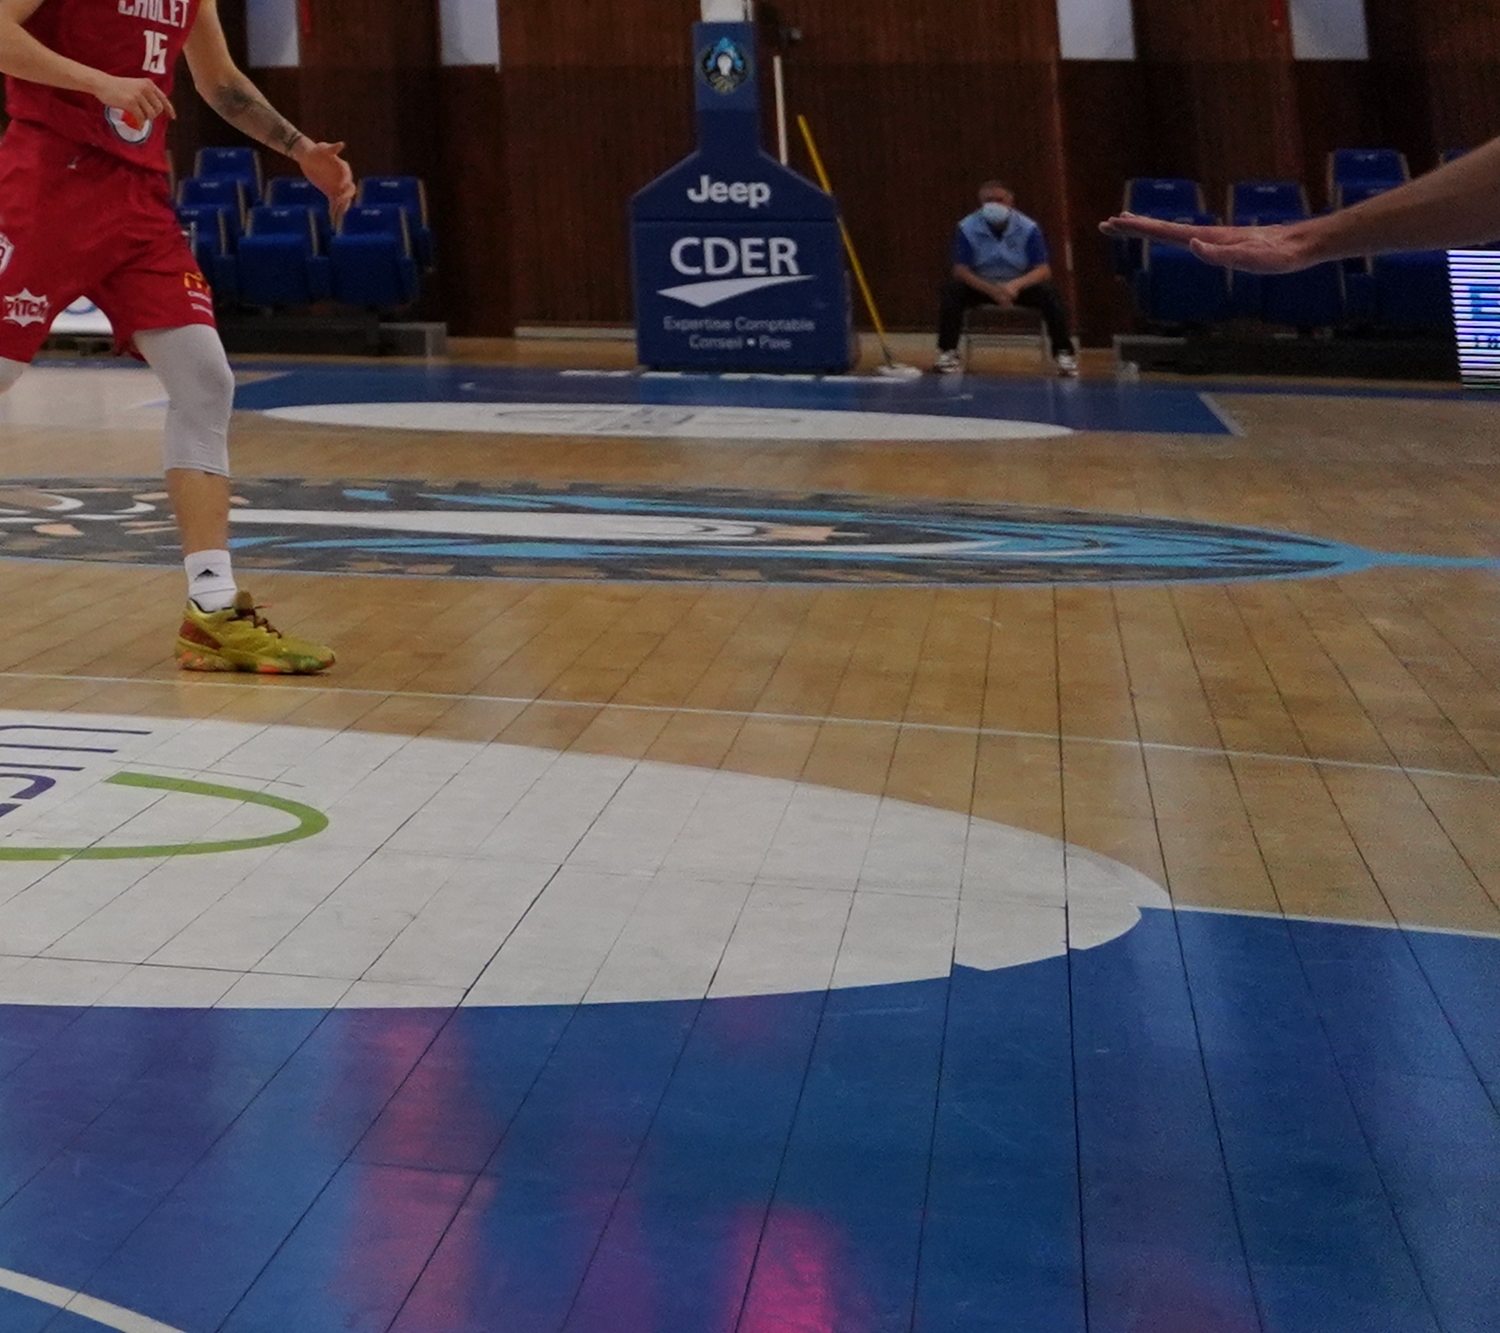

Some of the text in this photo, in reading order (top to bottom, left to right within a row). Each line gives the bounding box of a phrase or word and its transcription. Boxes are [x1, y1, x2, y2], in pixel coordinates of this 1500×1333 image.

[142, 30, 168, 74] 15
[687, 175, 771, 208] Jeep
[669, 237, 798, 275] CDER
[663, 315, 731, 333] Expertise
